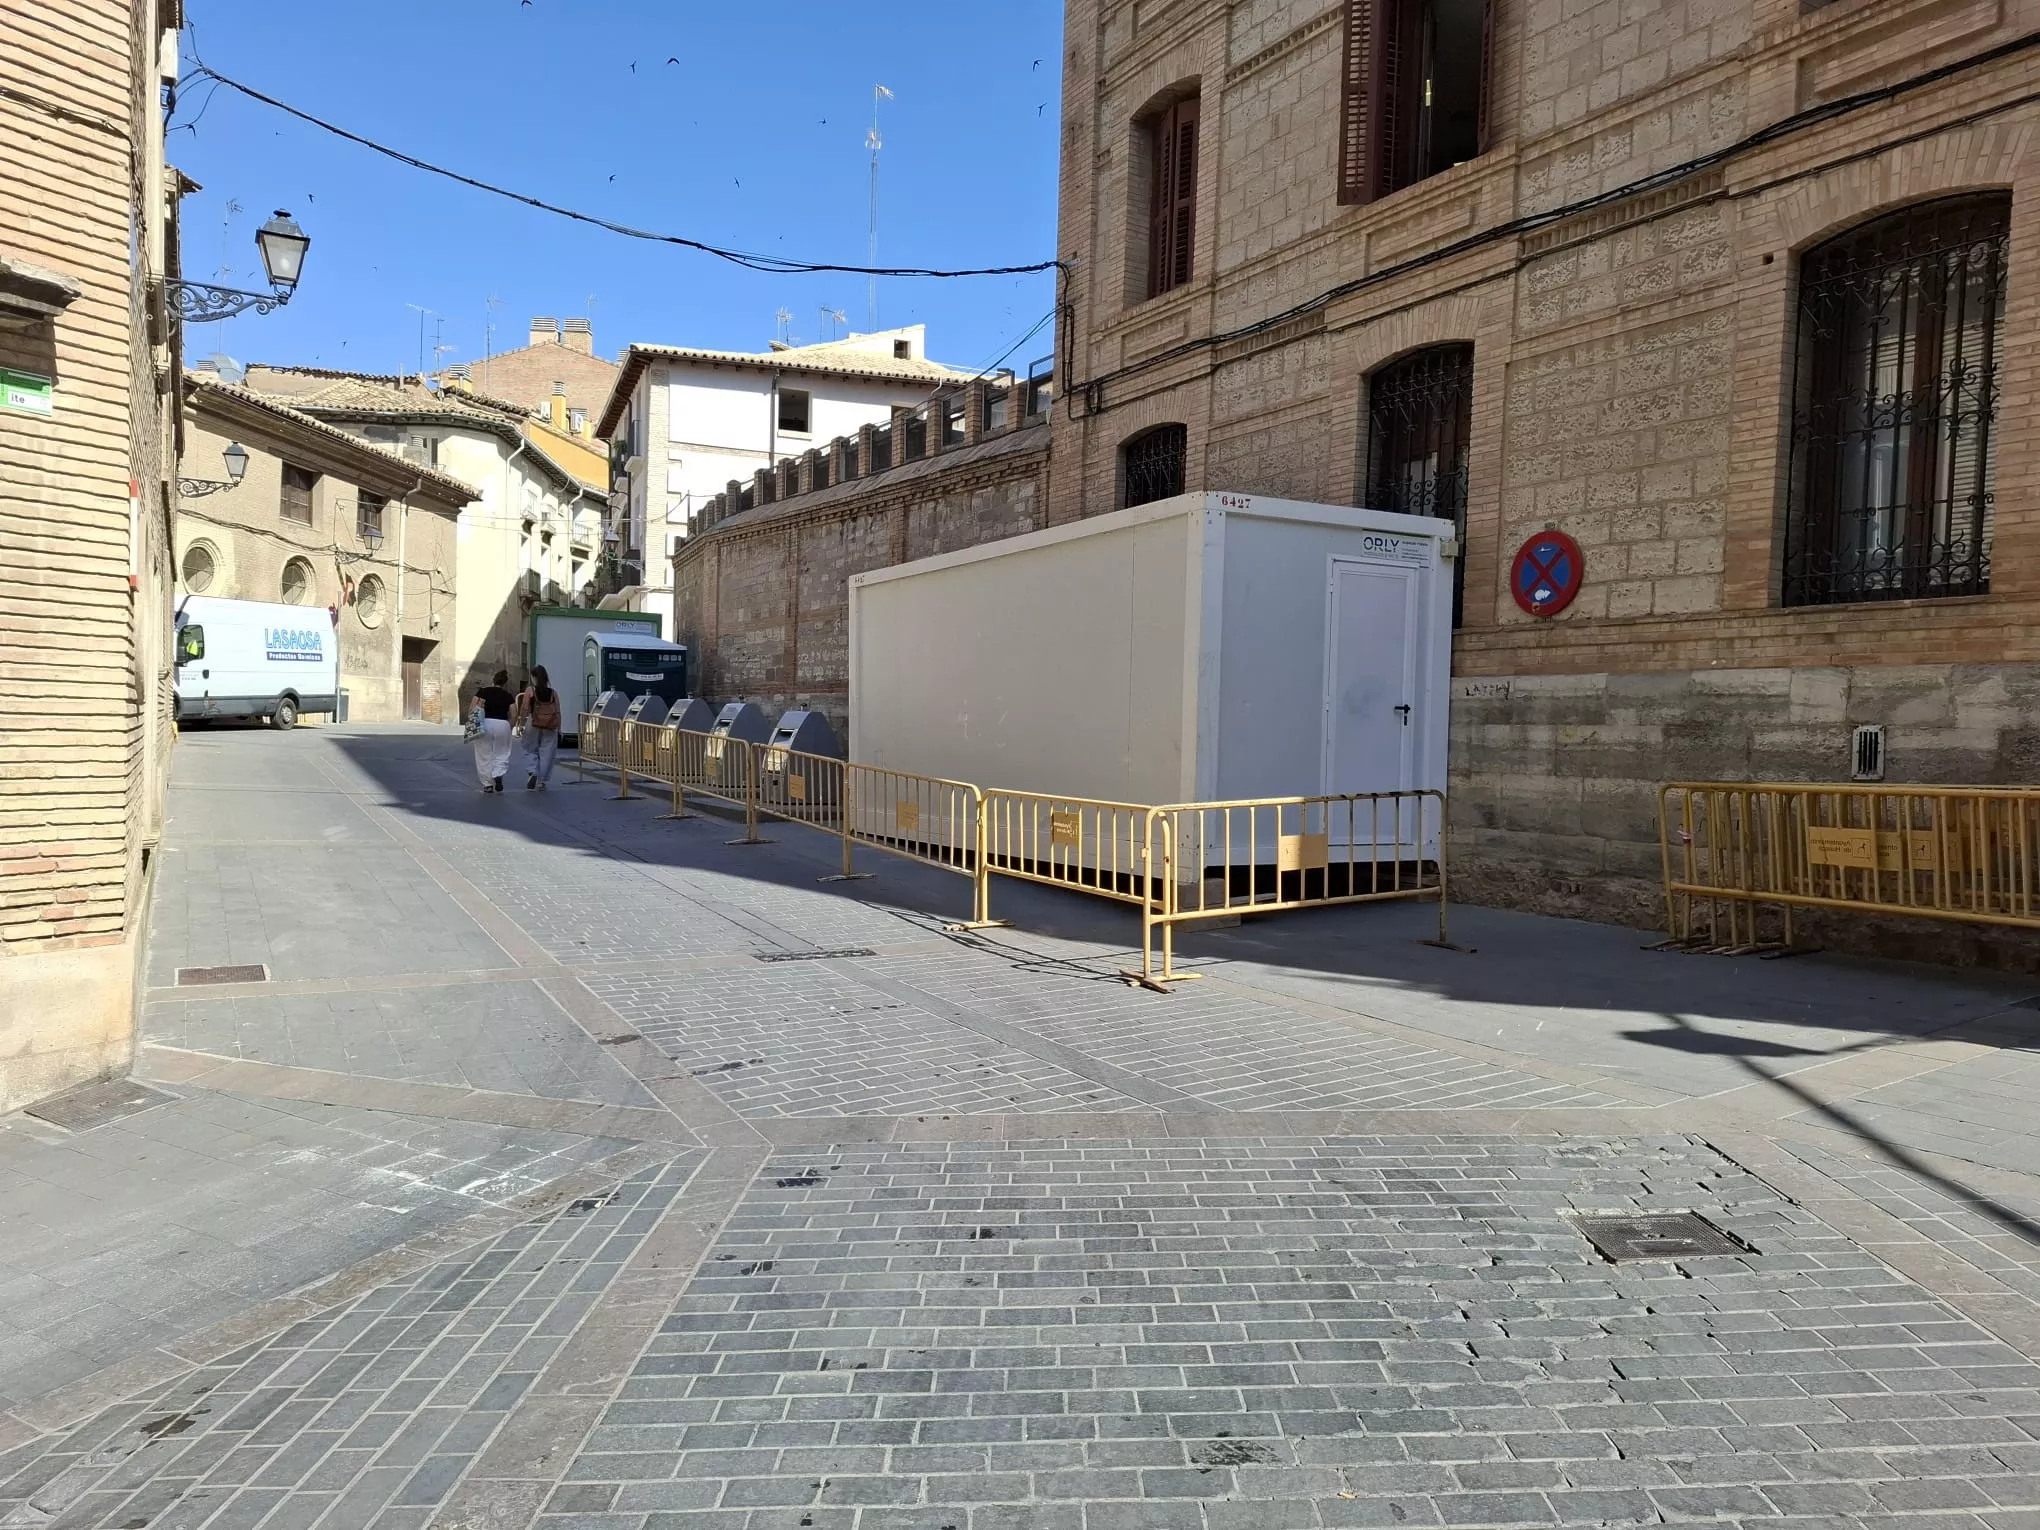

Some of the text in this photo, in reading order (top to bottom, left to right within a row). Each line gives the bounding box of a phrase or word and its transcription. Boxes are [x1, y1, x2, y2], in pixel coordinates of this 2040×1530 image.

[1221, 495, 1251, 509] 6427
[1363, 536, 1400, 553] ORLY
[264, 627, 322, 651] LASAOSA
